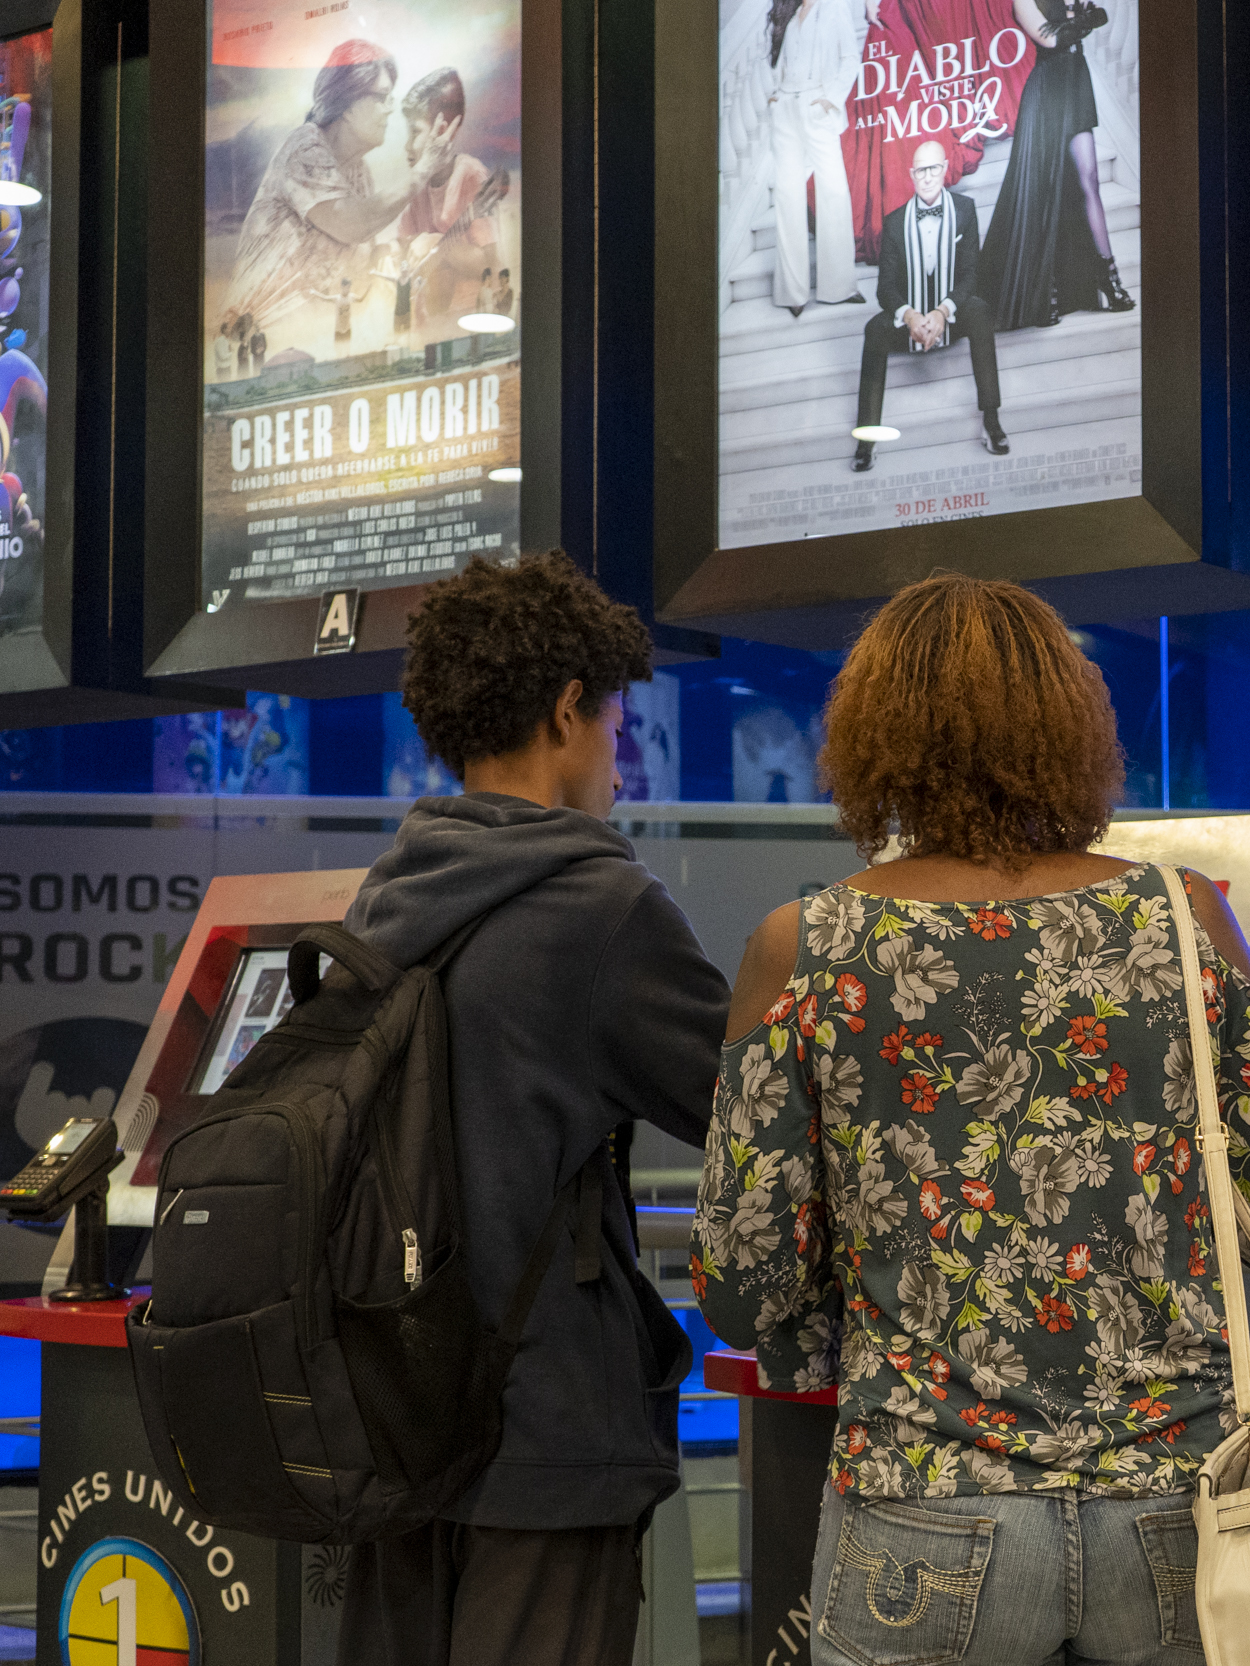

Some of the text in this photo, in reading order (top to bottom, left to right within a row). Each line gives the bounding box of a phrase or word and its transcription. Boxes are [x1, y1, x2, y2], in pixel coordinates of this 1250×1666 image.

[854, 27, 1027, 102] DIABLO
[868, 40, 893, 60] EL
[920, 77, 976, 104] VISTE
[855, 117, 866, 129] A
[867, 113, 886, 127] LA
[883, 93, 999, 143] MODA
[231, 374, 500, 473] CREER O MORIR
[231, 437, 499, 492] CUANDO SOLO QUEDA AFERRARSE A LA FE PARA VIVIR
[895, 492, 990, 518] 30 DE ABRIL
[319, 593, 349, 639] A
[0, 872, 201, 914] SOMOS
[0, 931, 190, 984] ROCK
[41, 1469, 250, 1613] CINES UNIDOS
[99, 1577, 137, 1666] 1
[765, 1588, 812, 1666] CIN
